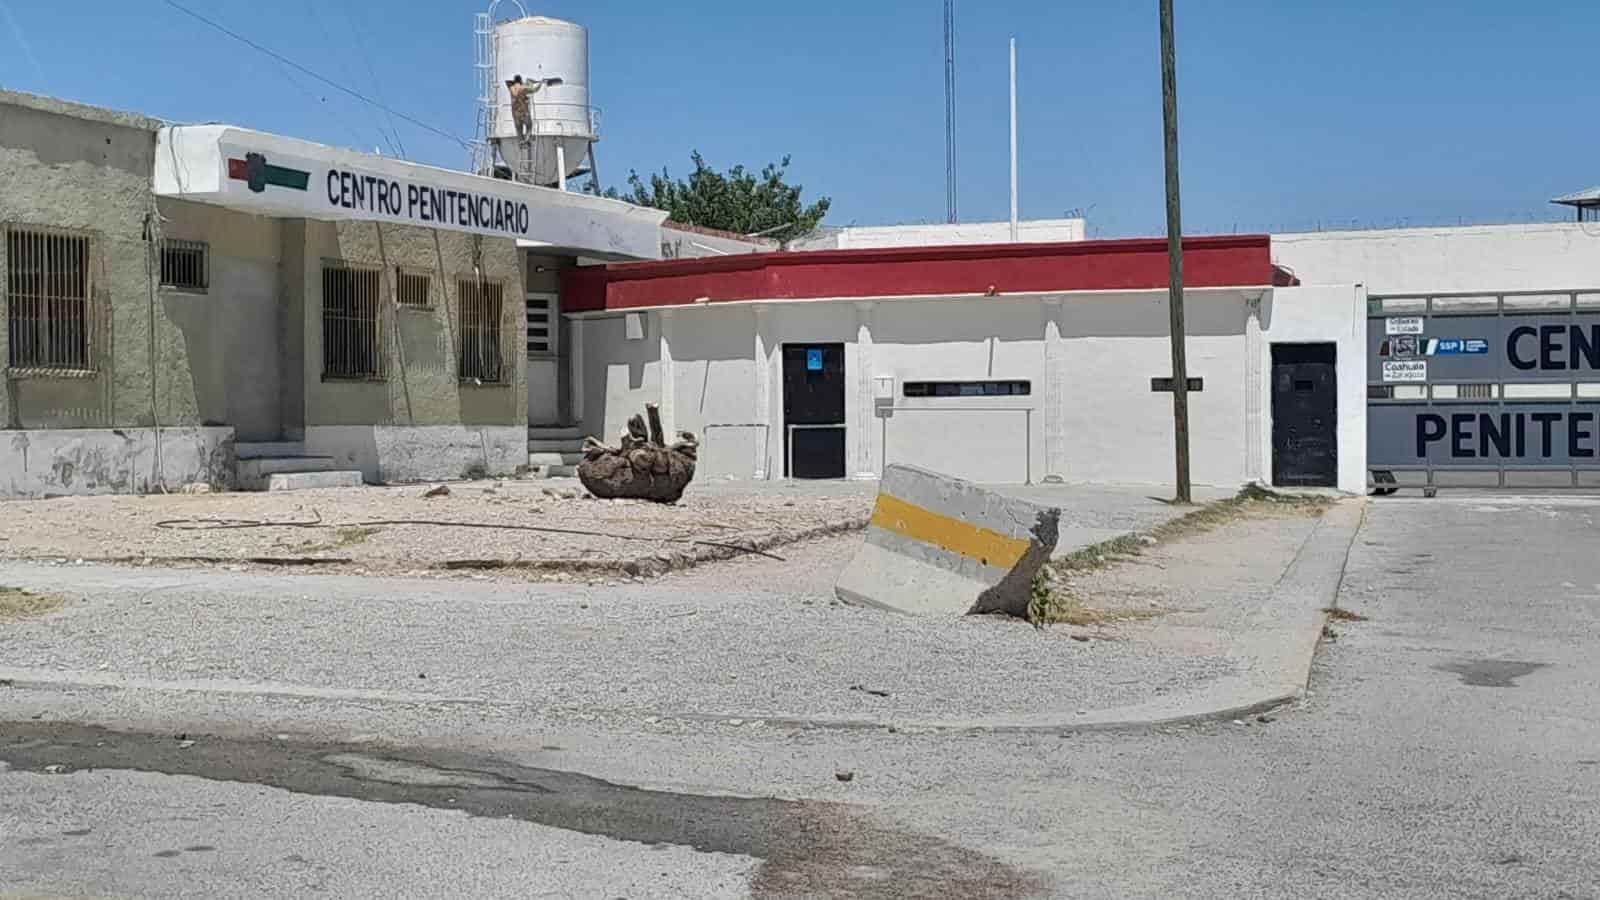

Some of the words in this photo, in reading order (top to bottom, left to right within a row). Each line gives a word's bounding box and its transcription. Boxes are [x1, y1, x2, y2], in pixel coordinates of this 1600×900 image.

[328, 169, 402, 216] CENTRO
[408, 184, 529, 234] PENITENCIARIO
[1384, 362, 1424, 371] Coahuila
[1440, 342, 1458, 350] SSP
[1507, 326, 1600, 370] CEN
[1416, 413, 1600, 458] PENITE
